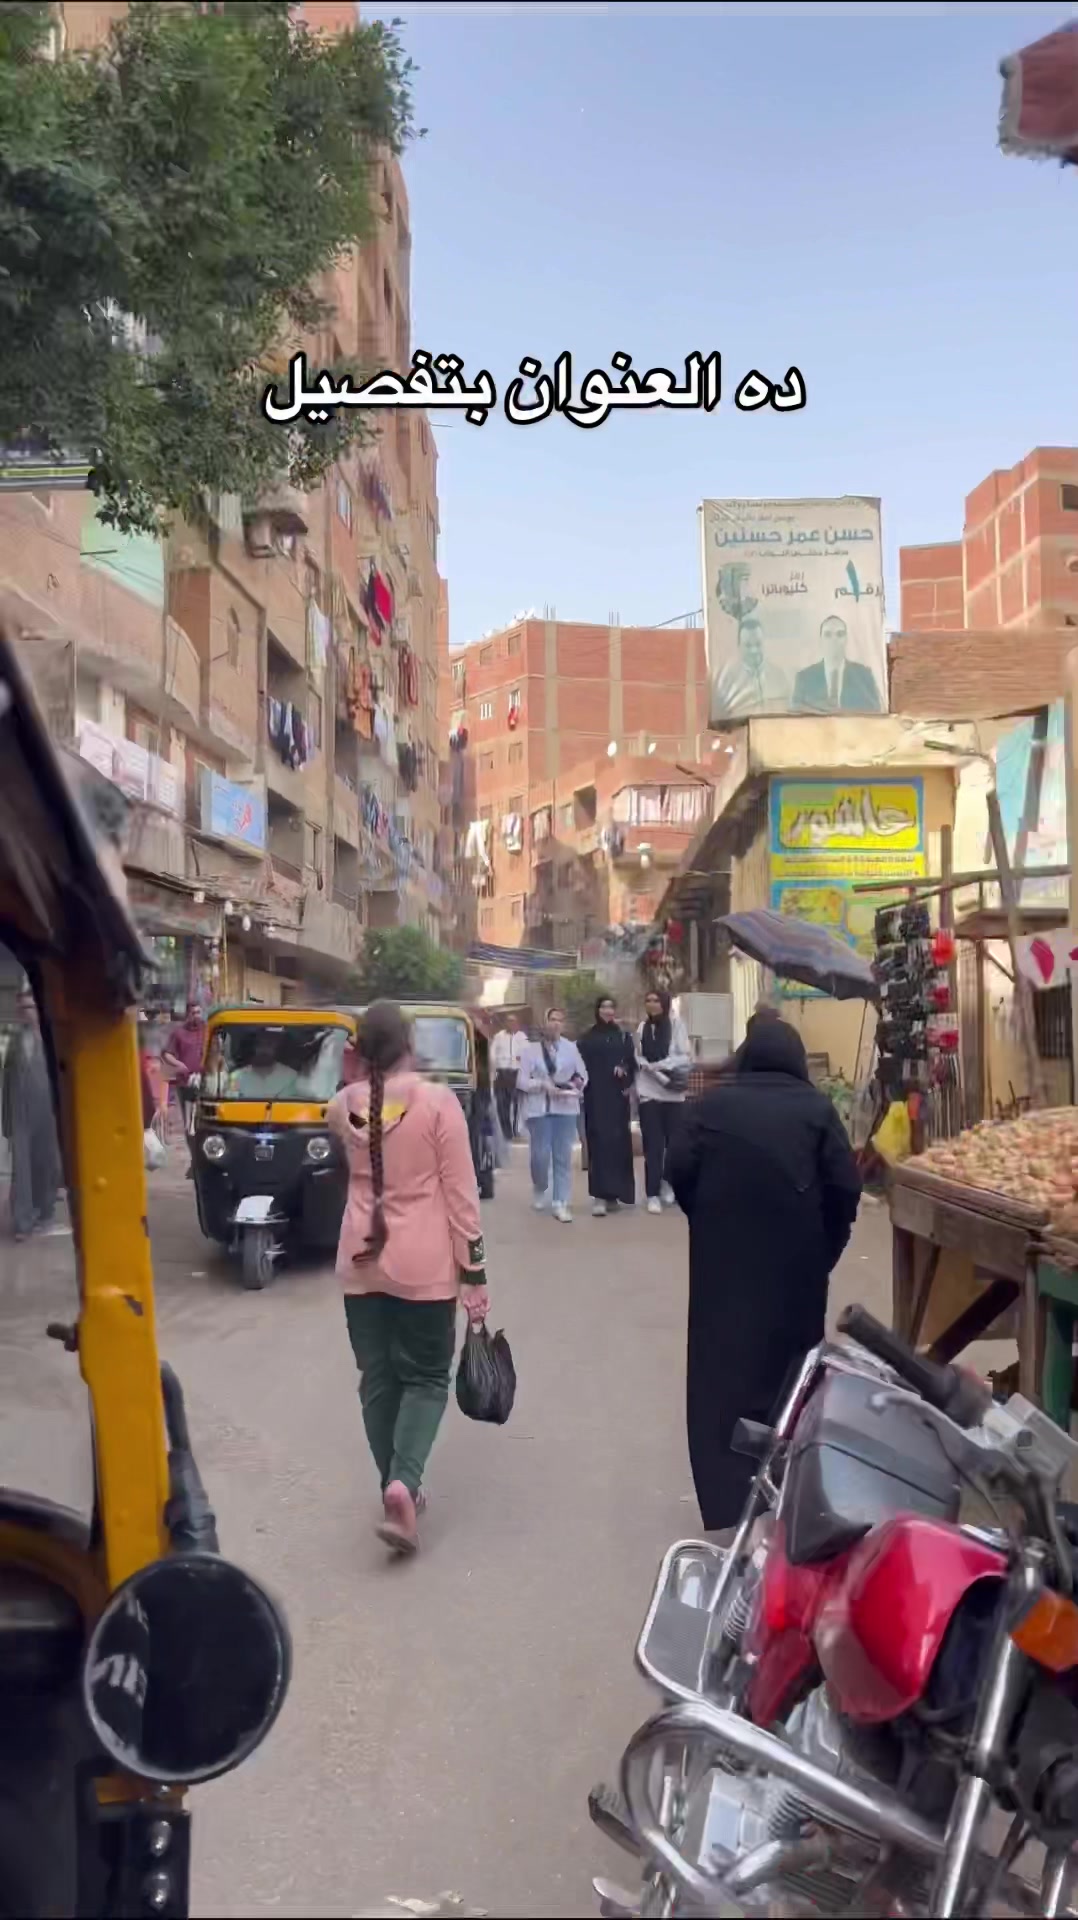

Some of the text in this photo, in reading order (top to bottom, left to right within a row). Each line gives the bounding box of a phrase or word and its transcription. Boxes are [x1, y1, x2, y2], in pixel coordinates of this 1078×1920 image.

[714, 525, 874, 547] حسن عمر حسنين
[761, 581, 809, 598] كليوباترا
